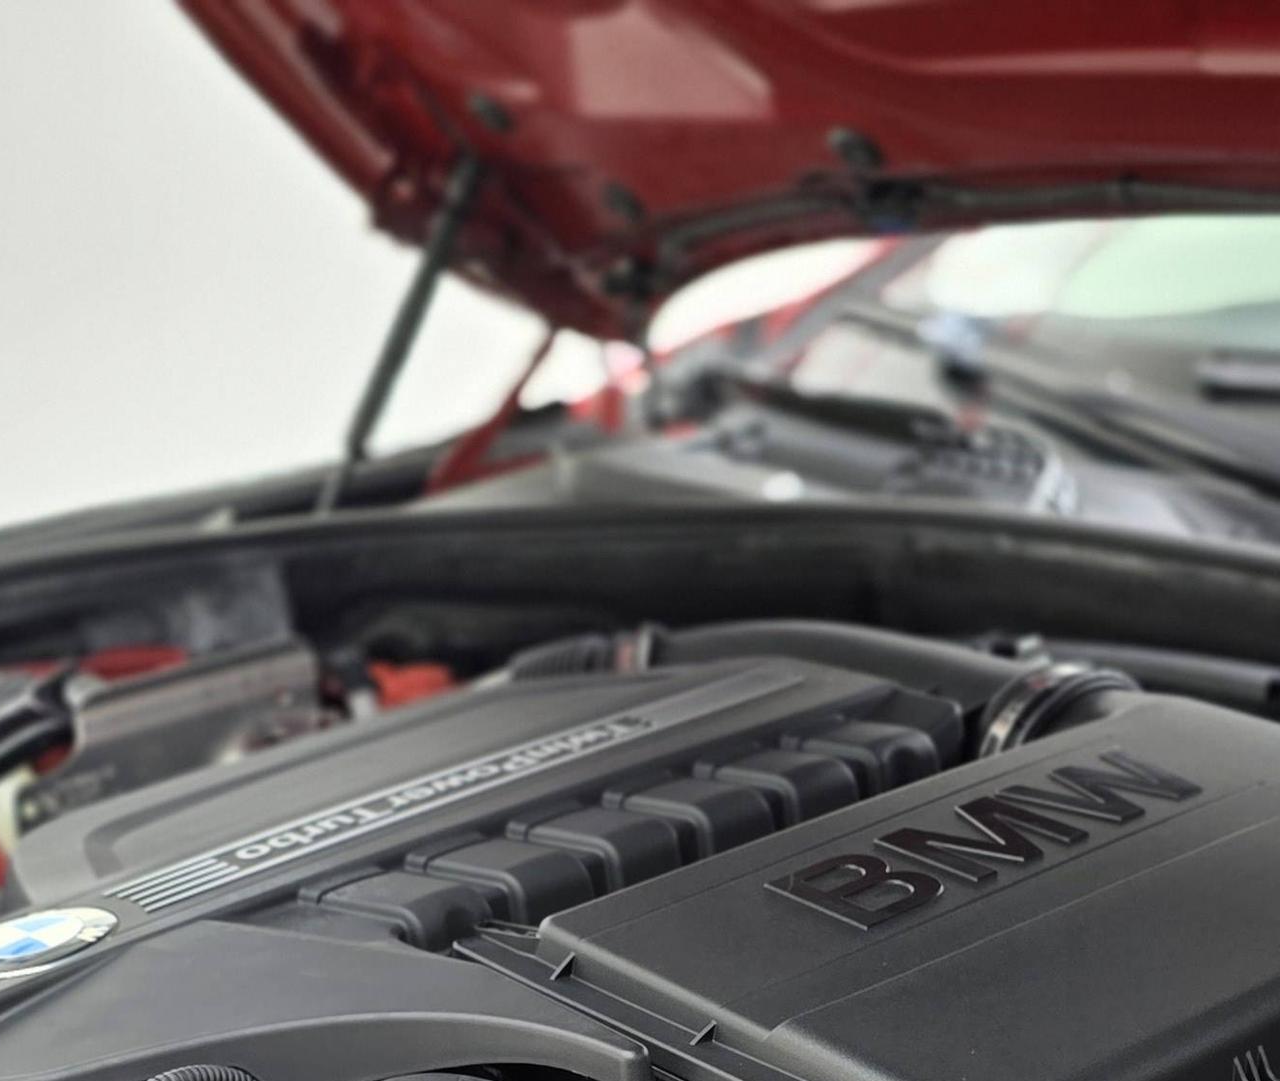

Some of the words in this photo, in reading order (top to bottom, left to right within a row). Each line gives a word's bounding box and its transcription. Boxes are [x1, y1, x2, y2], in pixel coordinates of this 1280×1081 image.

[376, 722, 640, 810] TwinPower
[235, 797, 395, 861] Turbo
[763, 748, 1204, 931] BMW
